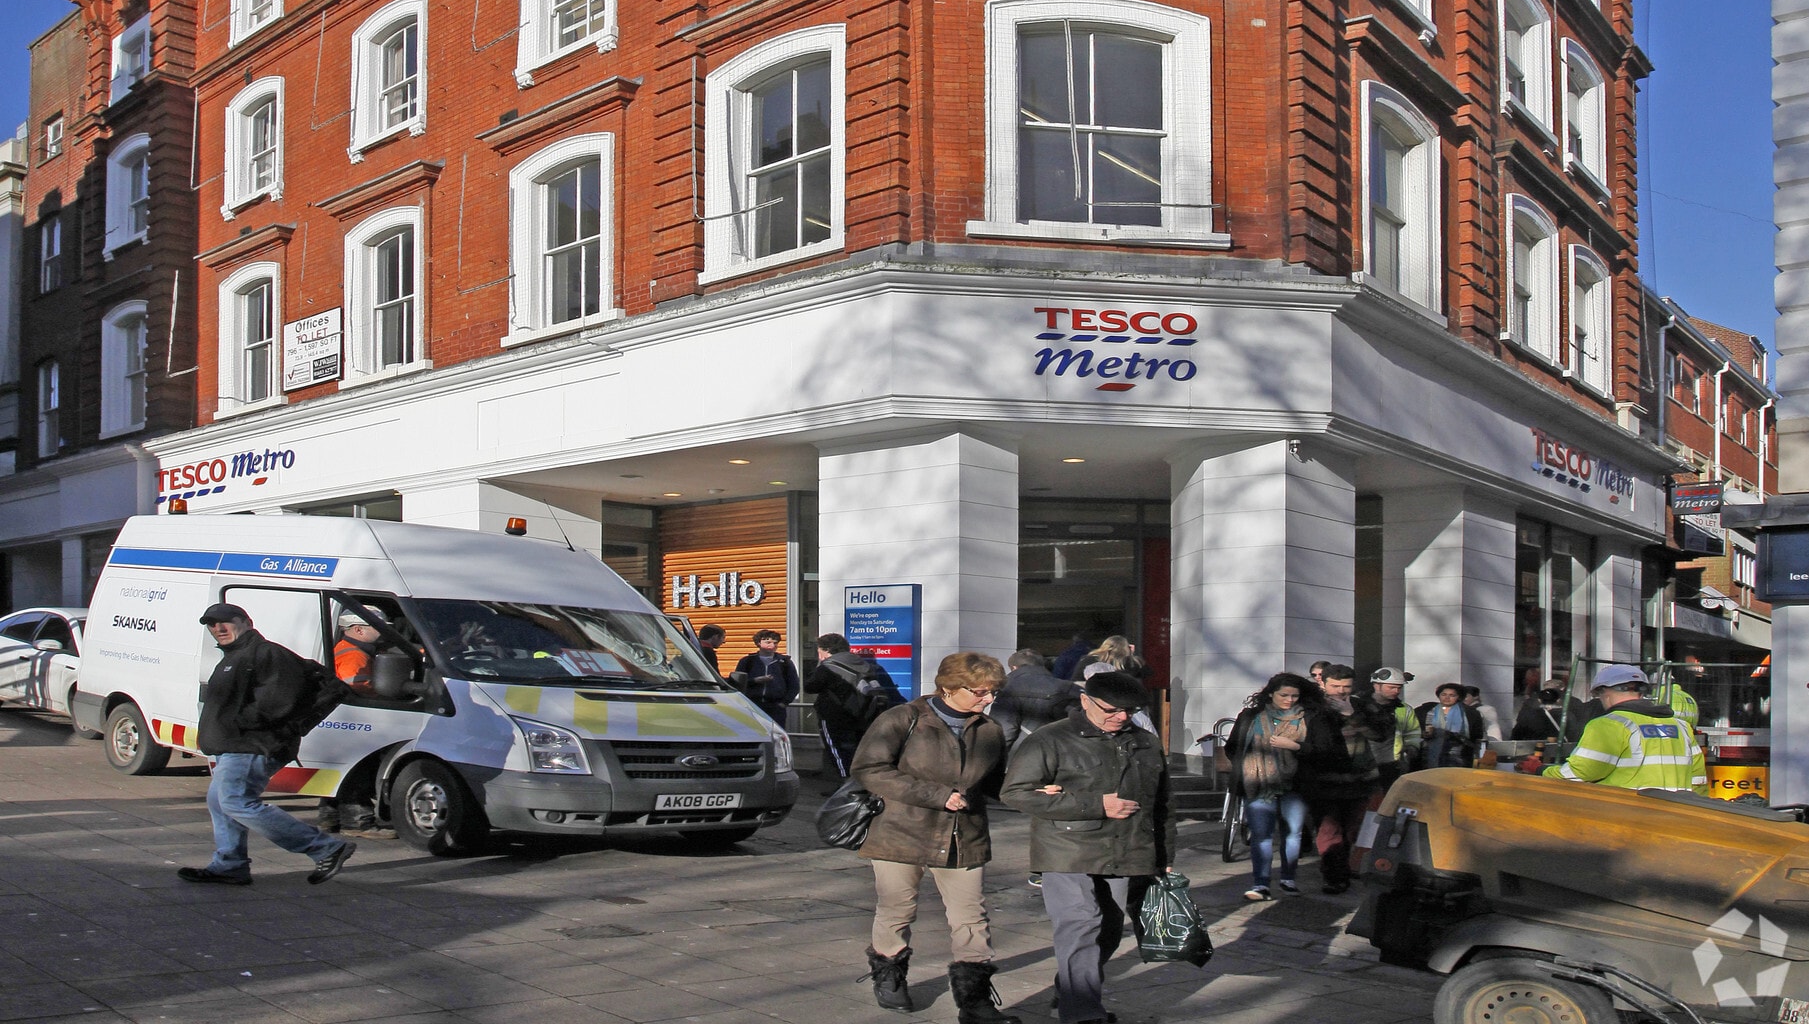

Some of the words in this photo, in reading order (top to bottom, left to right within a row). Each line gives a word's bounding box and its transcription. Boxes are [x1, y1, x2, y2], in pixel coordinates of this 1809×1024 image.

[295, 316, 329, 333] Offices
[1034, 307, 1198, 335] TESCO
[296, 333, 307, 344] TO
[311, 327, 328, 340] LET
[1530, 426, 1592, 482] TESCO
[154, 459, 227, 493] TESCO
[1675, 488, 1720, 496] TESCO
[260, 558, 280, 571] Gas
[284, 558, 328, 574] Alliance
[672, 571, 765, 608] Hello
[850, 591, 887, 604] Hello
[112, 615, 157, 633] SKANSKA
[849, 626, 866, 634] 7am
[875, 625, 898, 635] 10pm
[99, 648, 122, 661] Improving
[140, 655, 161, 664] Network
[663, 796, 703, 808] AK08
[705, 795, 734, 807] GGP
